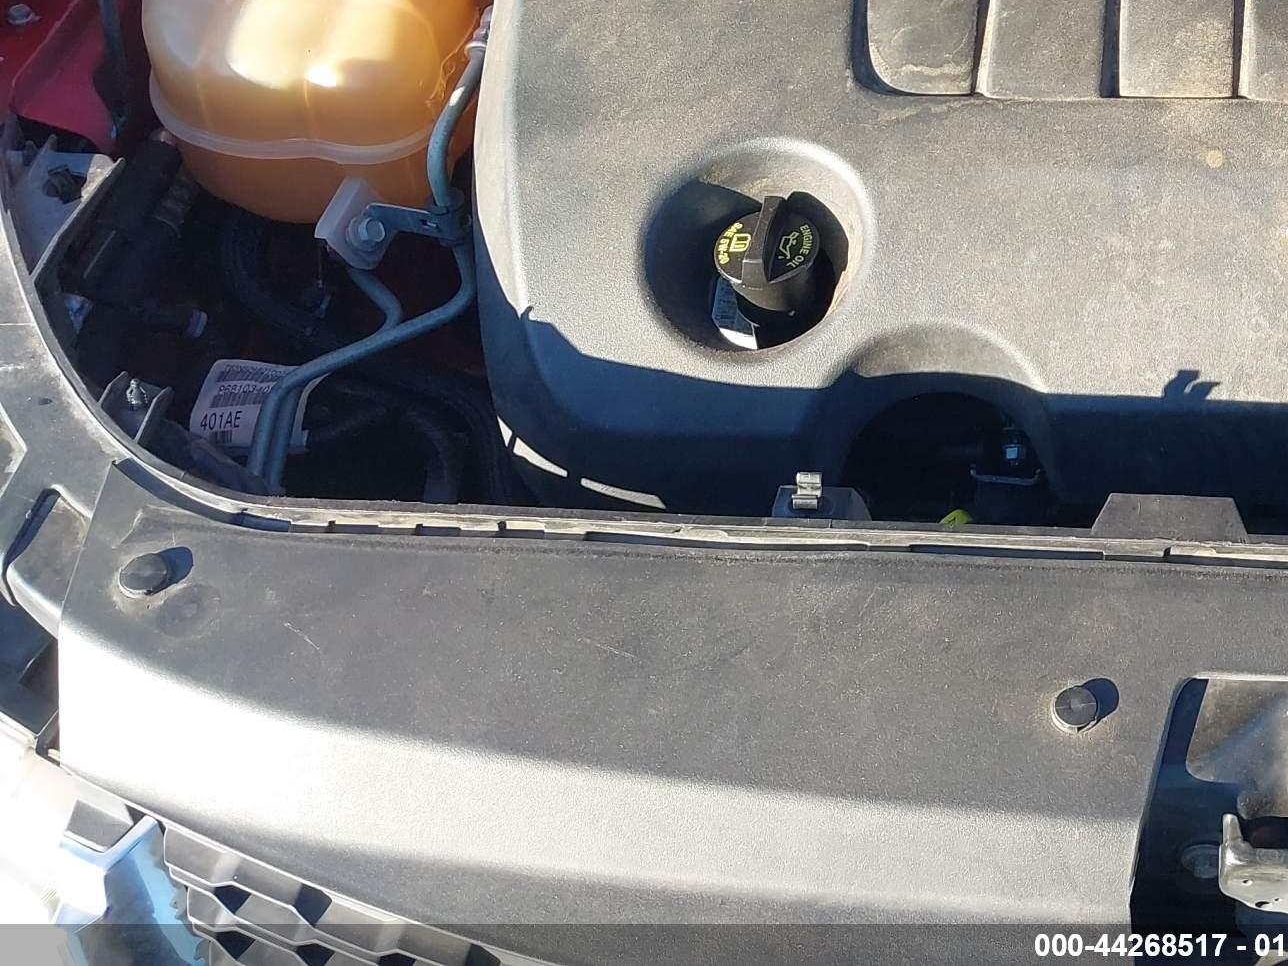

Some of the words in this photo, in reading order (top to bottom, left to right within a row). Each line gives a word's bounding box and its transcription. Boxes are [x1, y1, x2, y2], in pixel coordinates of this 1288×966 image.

[723, 222, 743, 238] SAE
[799, 224, 813, 255] ENGINE
[718, 238, 730, 265] 5W-20
[786, 254, 804, 268] OIL
[200, 411, 243, 430] 401AE
